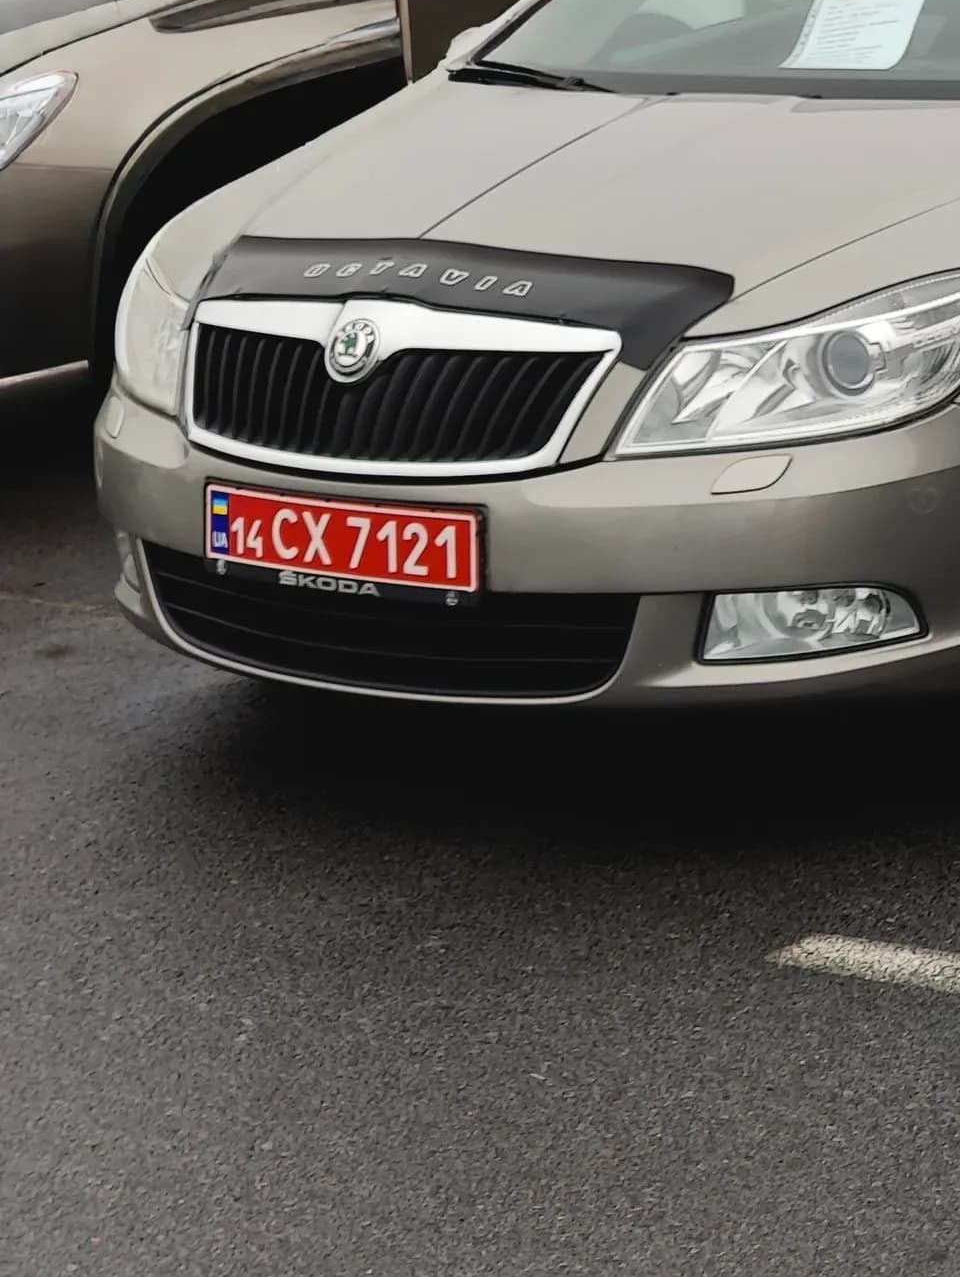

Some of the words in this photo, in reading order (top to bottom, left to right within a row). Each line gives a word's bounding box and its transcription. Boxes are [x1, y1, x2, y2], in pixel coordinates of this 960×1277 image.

[303, 260, 533, 298] OCTAVIA
[211, 531, 229, 549] UA
[229, 516, 264, 558] 14
[271, 508, 333, 566] CX
[345, 515, 457, 580] 7121
[278, 569, 381, 597] ŠKODA
